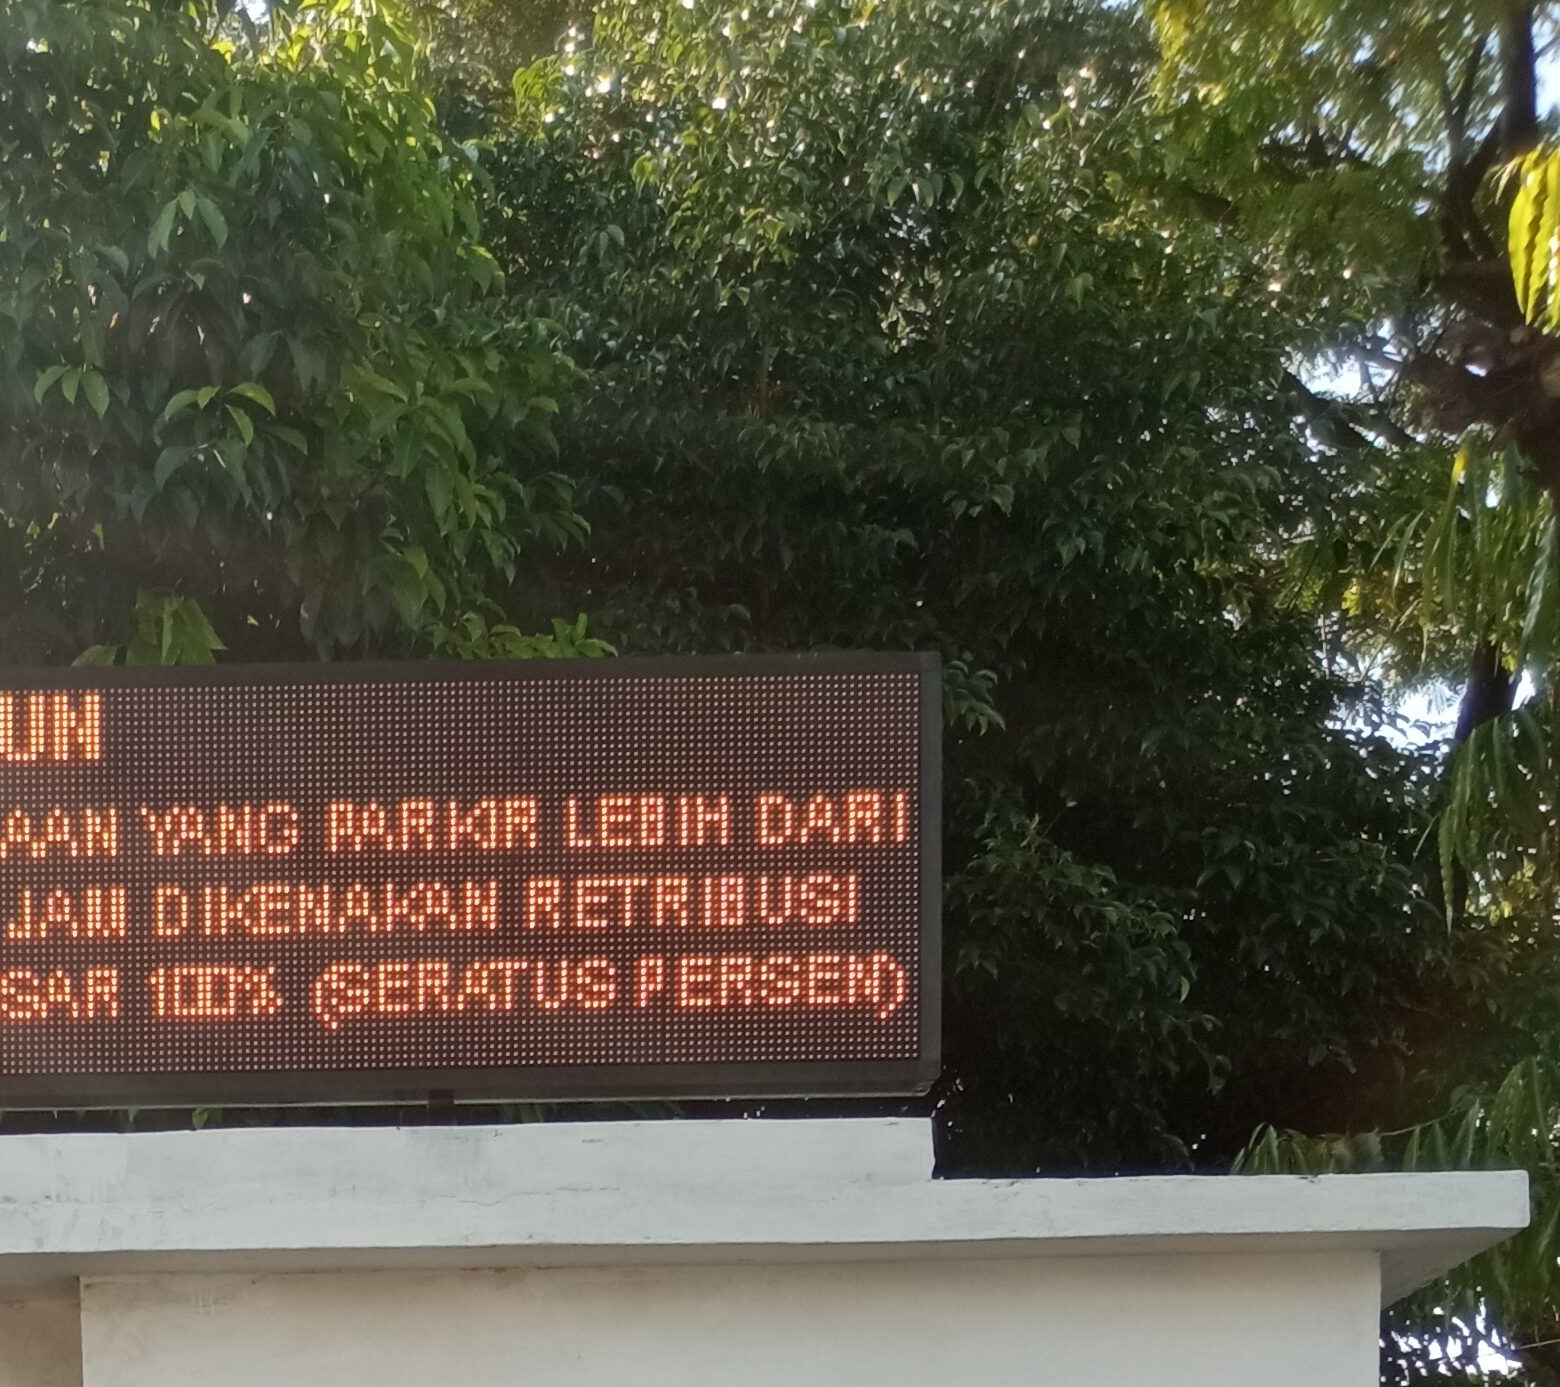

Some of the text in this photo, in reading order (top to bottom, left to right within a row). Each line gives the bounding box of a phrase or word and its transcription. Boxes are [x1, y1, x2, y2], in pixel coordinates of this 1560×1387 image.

[140, 801, 298, 856] YANG
[328, 797, 537, 853] PARKIR
[567, 793, 730, 848] LEBIH
[756, 790, 908, 846] DARI
[6, 884, 127, 941] JAM
[153, 880, 500, 938] DIKENAKAN
[526, 872, 860, 930] RETRIBUSI
[149, 964, 284, 1018] 100%
[313, 957, 617, 1030] (SERATUS
[637, 951, 908, 1020] PERSEN)
